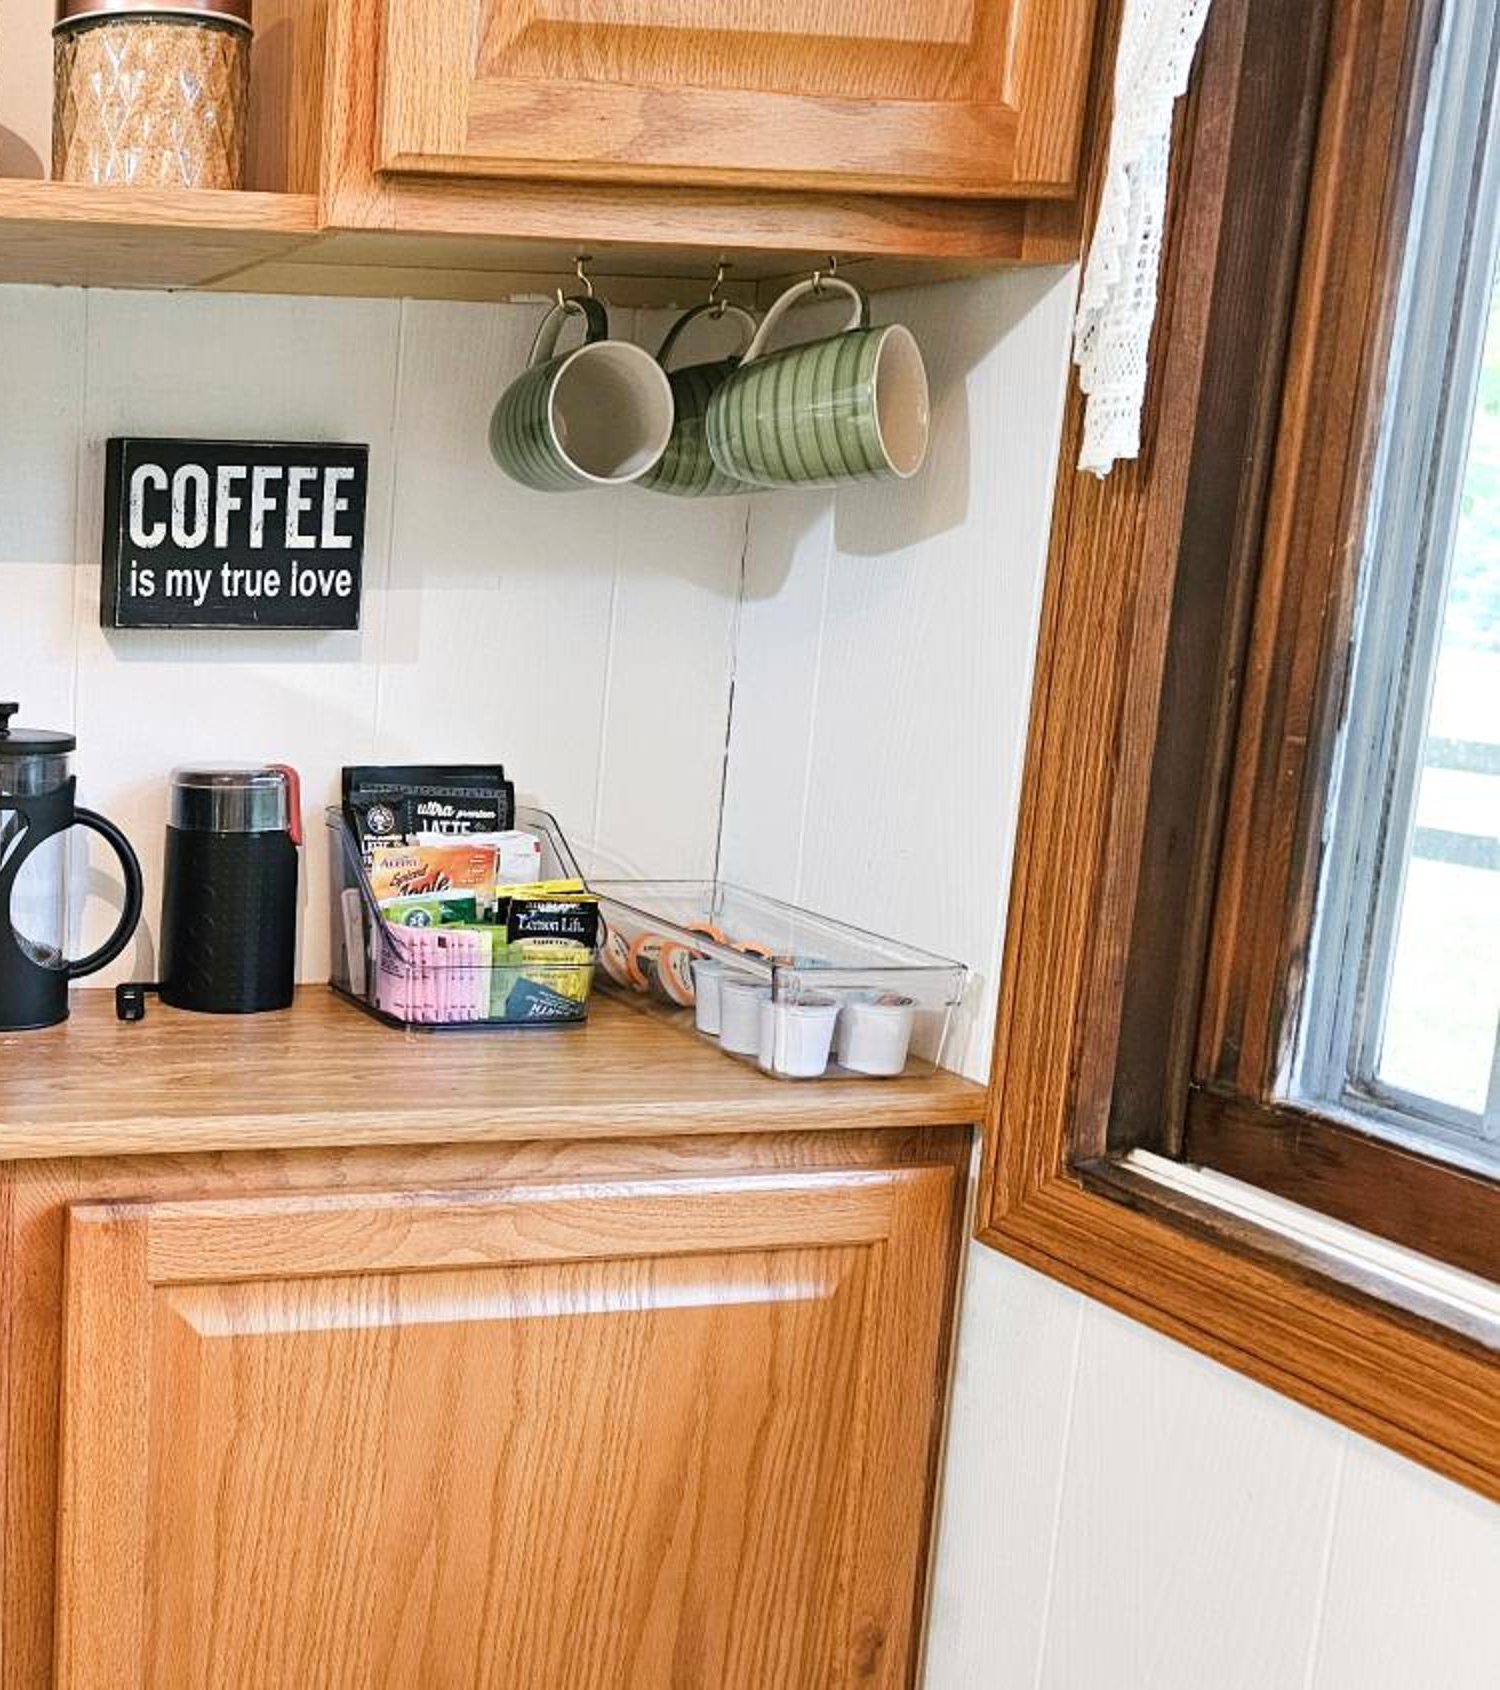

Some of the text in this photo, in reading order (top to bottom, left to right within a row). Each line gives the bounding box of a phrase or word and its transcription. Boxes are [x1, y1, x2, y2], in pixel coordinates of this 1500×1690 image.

[129, 463, 355, 549] COFFEE
[130, 560, 352, 607] is my true love
[417, 801, 455, 818] ultra
